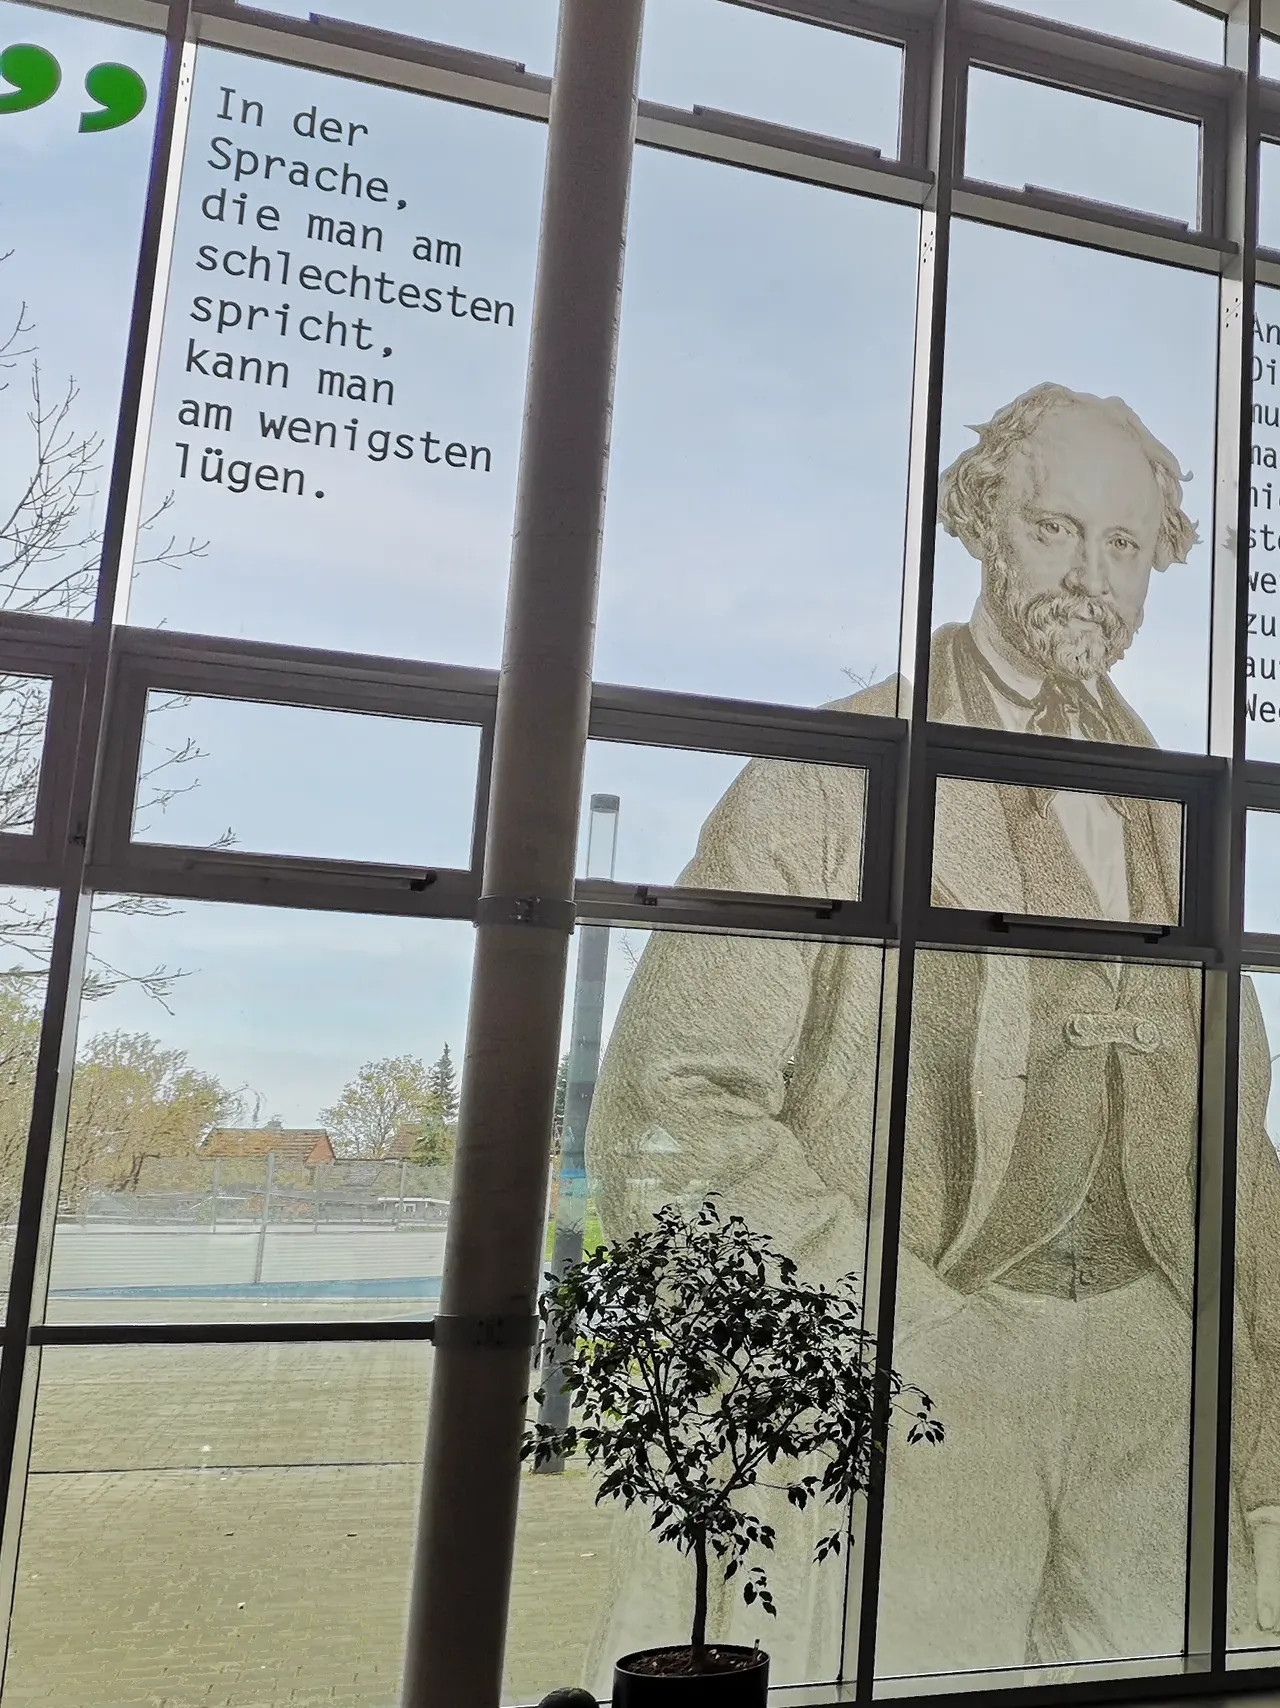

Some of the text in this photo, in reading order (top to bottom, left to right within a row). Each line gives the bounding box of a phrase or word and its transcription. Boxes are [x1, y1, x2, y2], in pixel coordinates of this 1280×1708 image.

[217, 86, 369, 146] In der
[207, 137, 406, 210] Sprache,
[201, 188, 462, 267] die man am
[195, 244, 514, 327] schlechtesten
[190, 295, 393, 358] spricht,
[185, 338, 394, 406] kann man
[177, 398, 492, 472] am wenigsten
[174, 442, 325, 500] lügen.
[1246, 612, 1276, 638] zu
